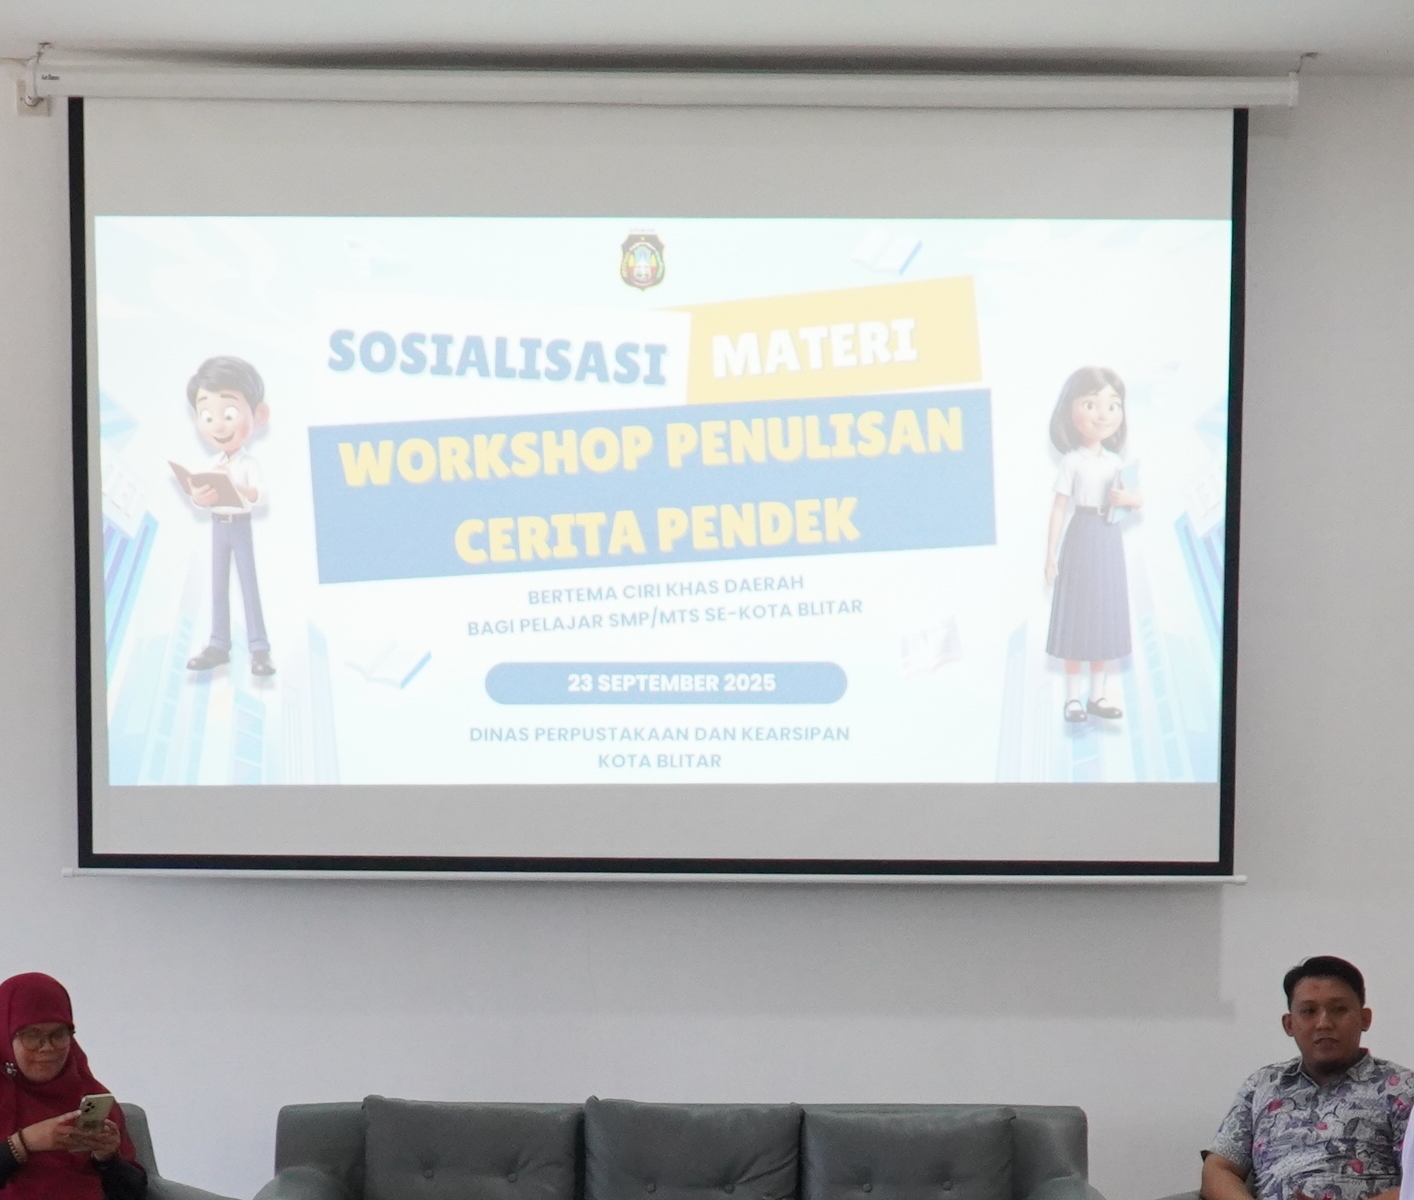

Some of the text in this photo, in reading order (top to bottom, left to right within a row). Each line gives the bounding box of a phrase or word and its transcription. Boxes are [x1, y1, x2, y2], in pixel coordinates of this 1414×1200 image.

[328, 318, 918, 385] SOSIALISASI MATERI
[338, 407, 963, 487] WORKSHOP PENULISAN
[454, 497, 861, 564] CERITA PENDEK
[528, 575, 804, 605] BERTEMA CIRI KHAS DAERAH
[468, 599, 863, 636] BAGI PELAJAR SMP/MTS SE-KOTA BLITAR
[568, 673, 776, 692] 23 SEPTEMBER 2025
[470, 726, 850, 742] DINAS PERPUSTAKAAN DAN KEARSIPAN
[598, 753, 722, 768] KOTA BLITAR
